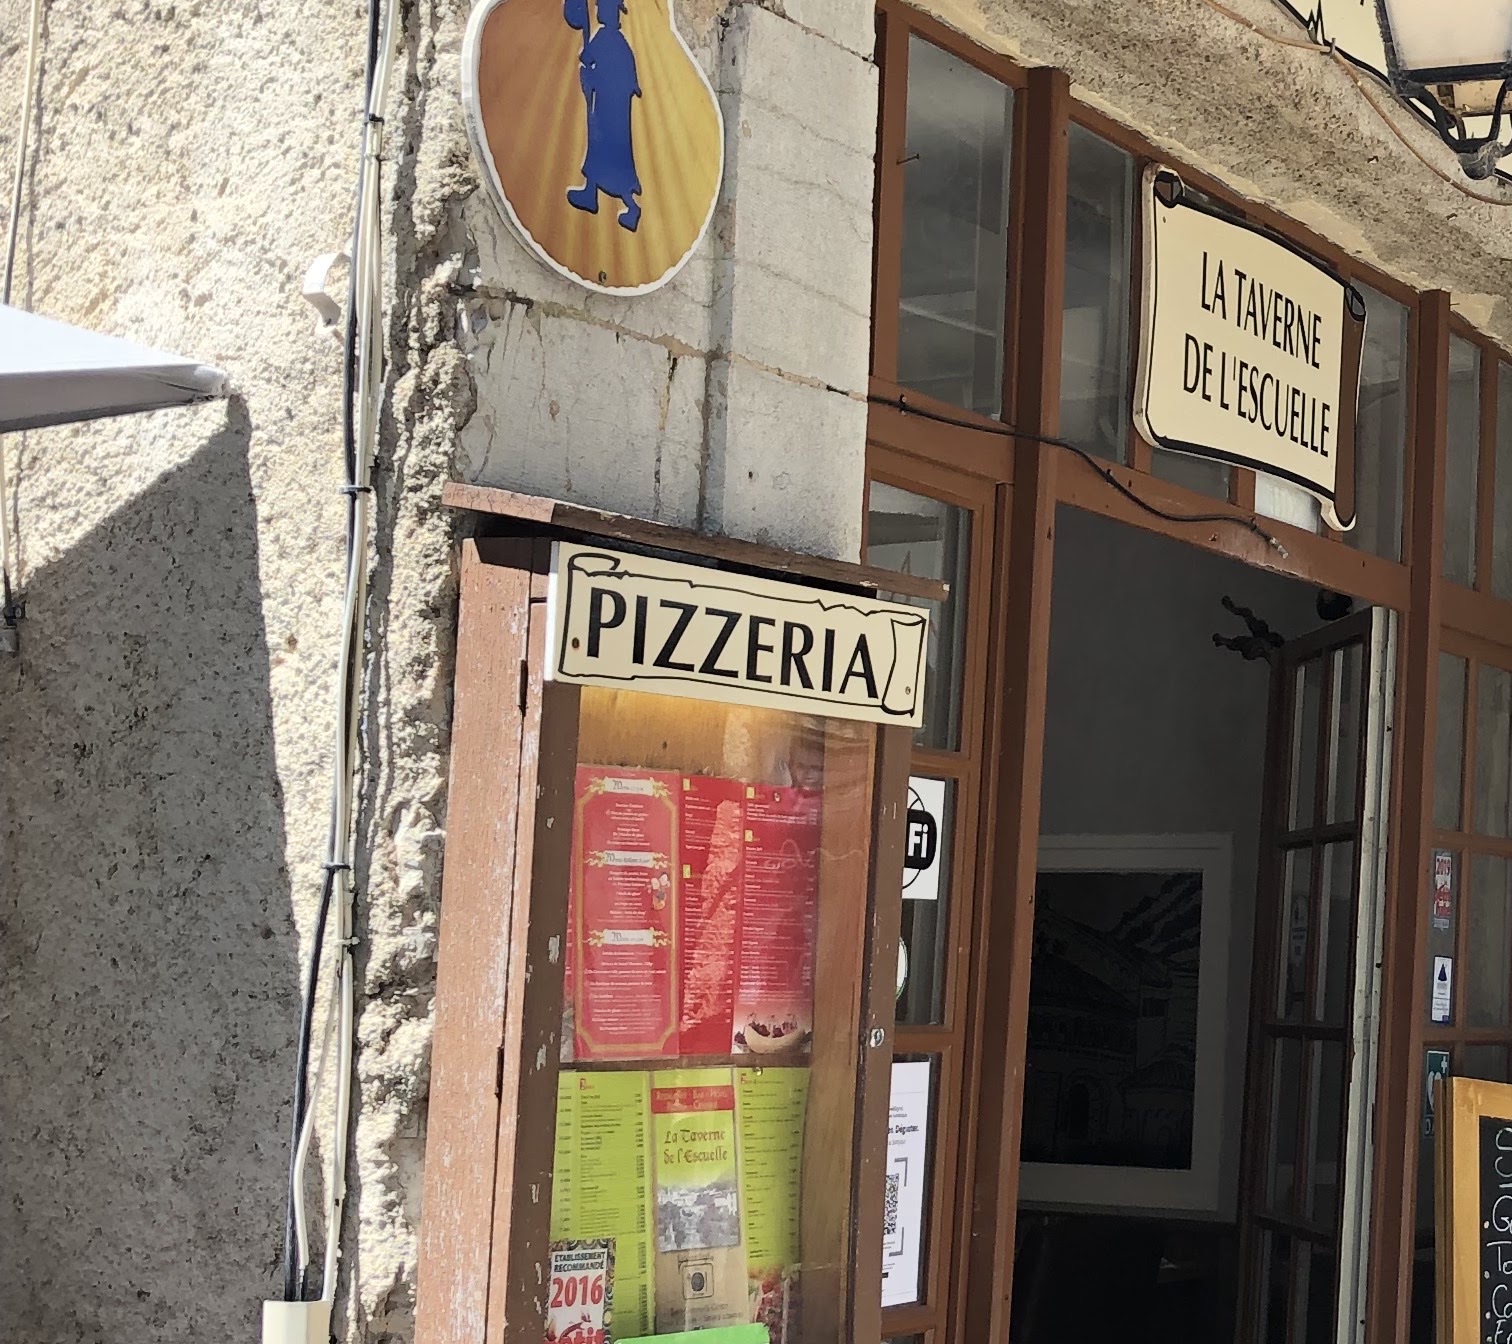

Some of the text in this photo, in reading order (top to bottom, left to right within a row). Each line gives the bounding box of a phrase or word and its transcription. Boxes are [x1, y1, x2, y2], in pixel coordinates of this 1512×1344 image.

[1200, 251, 1322, 370] LA TAVERNE
[1183, 332, 1331, 458] DE L'ESCUELLE
[586, 586, 880, 699] PIZZERIA
[907, 822, 929, 859] Fi
[550, 1275, 604, 1309] 2016
